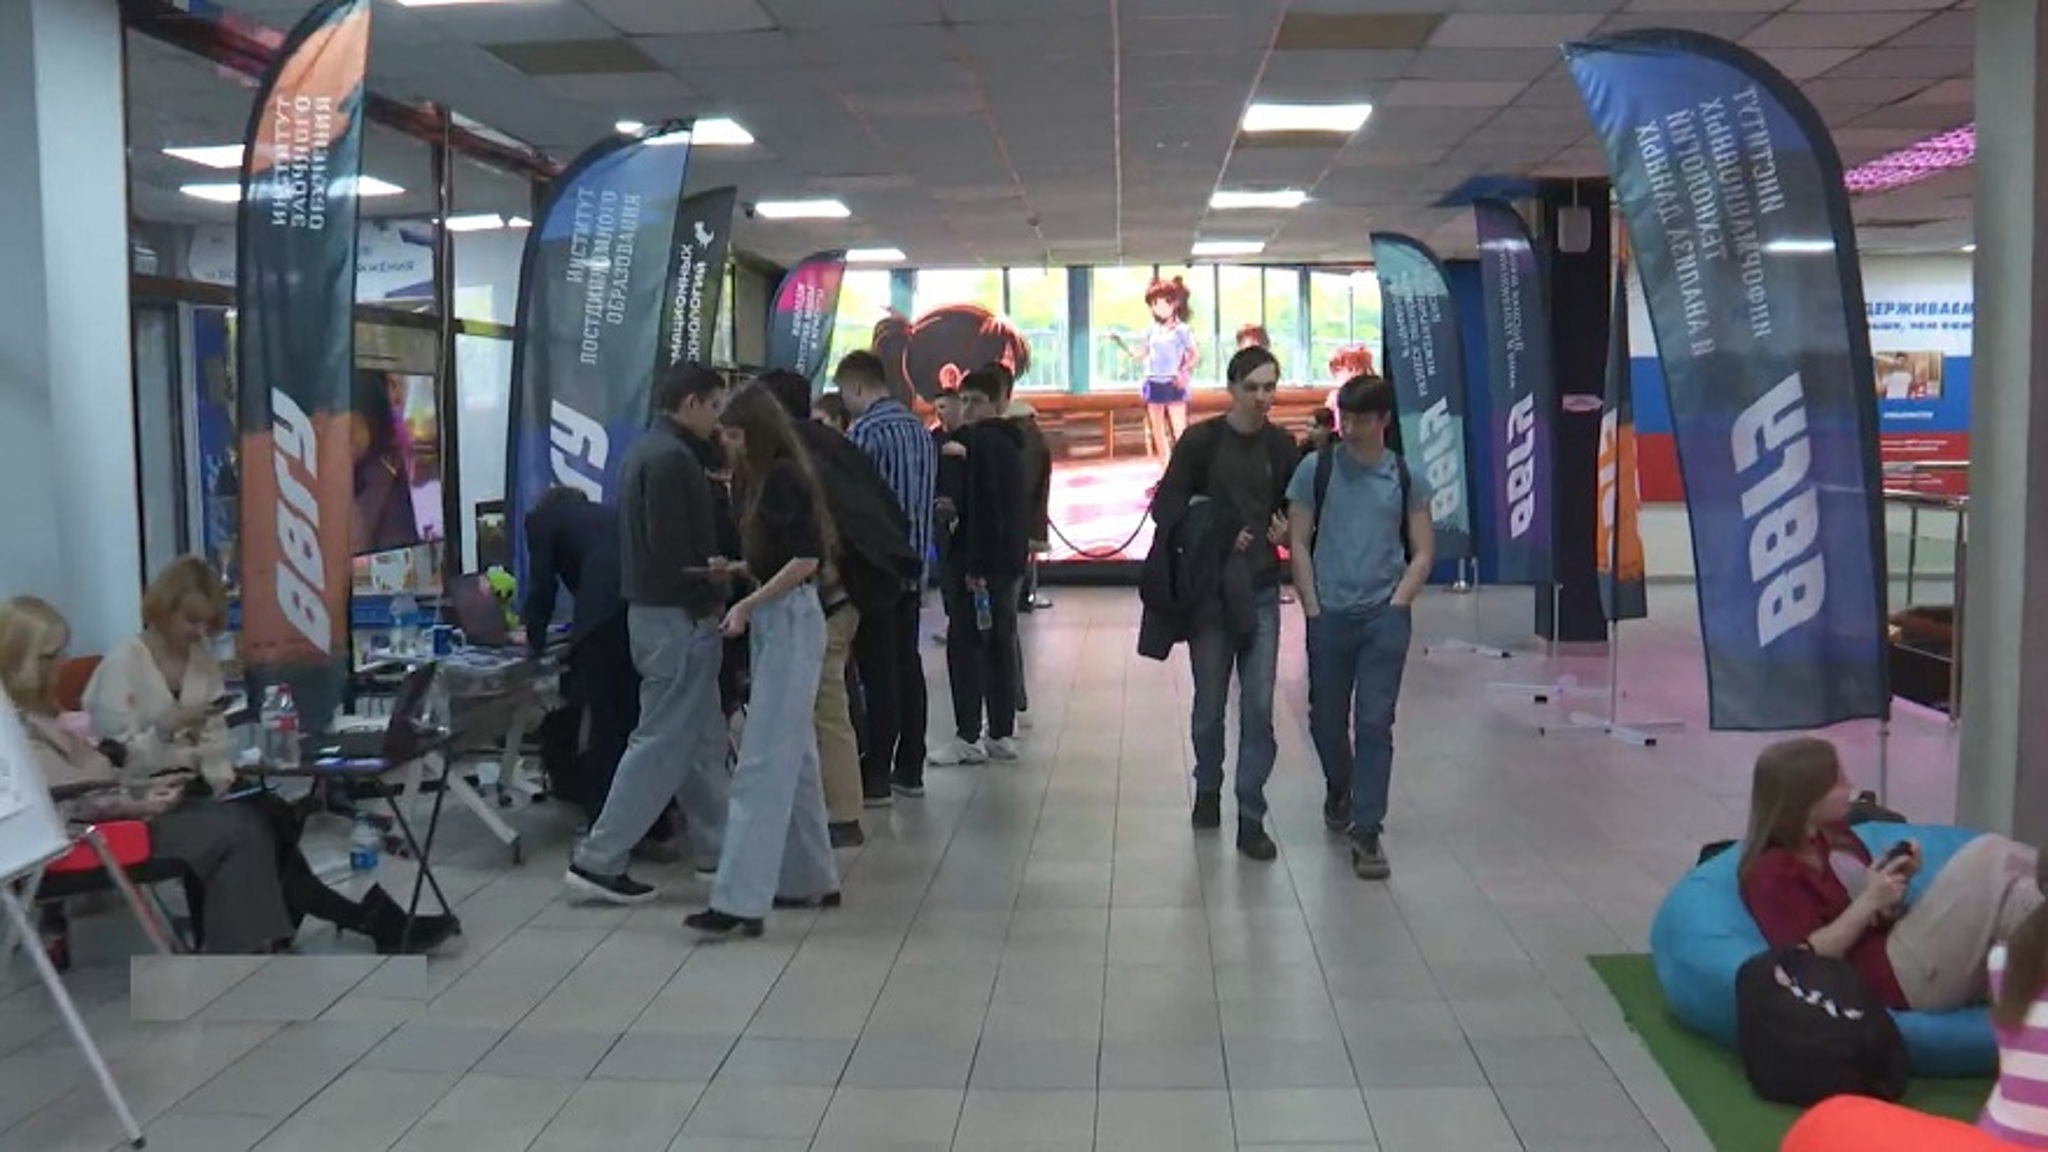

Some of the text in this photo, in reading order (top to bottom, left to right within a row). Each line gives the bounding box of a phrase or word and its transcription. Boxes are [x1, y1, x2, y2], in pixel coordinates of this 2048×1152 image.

[271, 94, 292, 226] ИНСТИТУТ
[290, 95, 312, 228] ЗАОЧНОГО
[308, 95, 332, 230] ОБУЧЕНИЯ
[566, 185, 595, 284] ИНСТИТУТ
[606, 193, 641, 325] ОБРАЗОВАНИЯ
[671, 243, 693, 366] МАЦИОННЫХ
[549, 398, 609, 504] ГУ
[269, 386, 332, 655] ВВГУ
